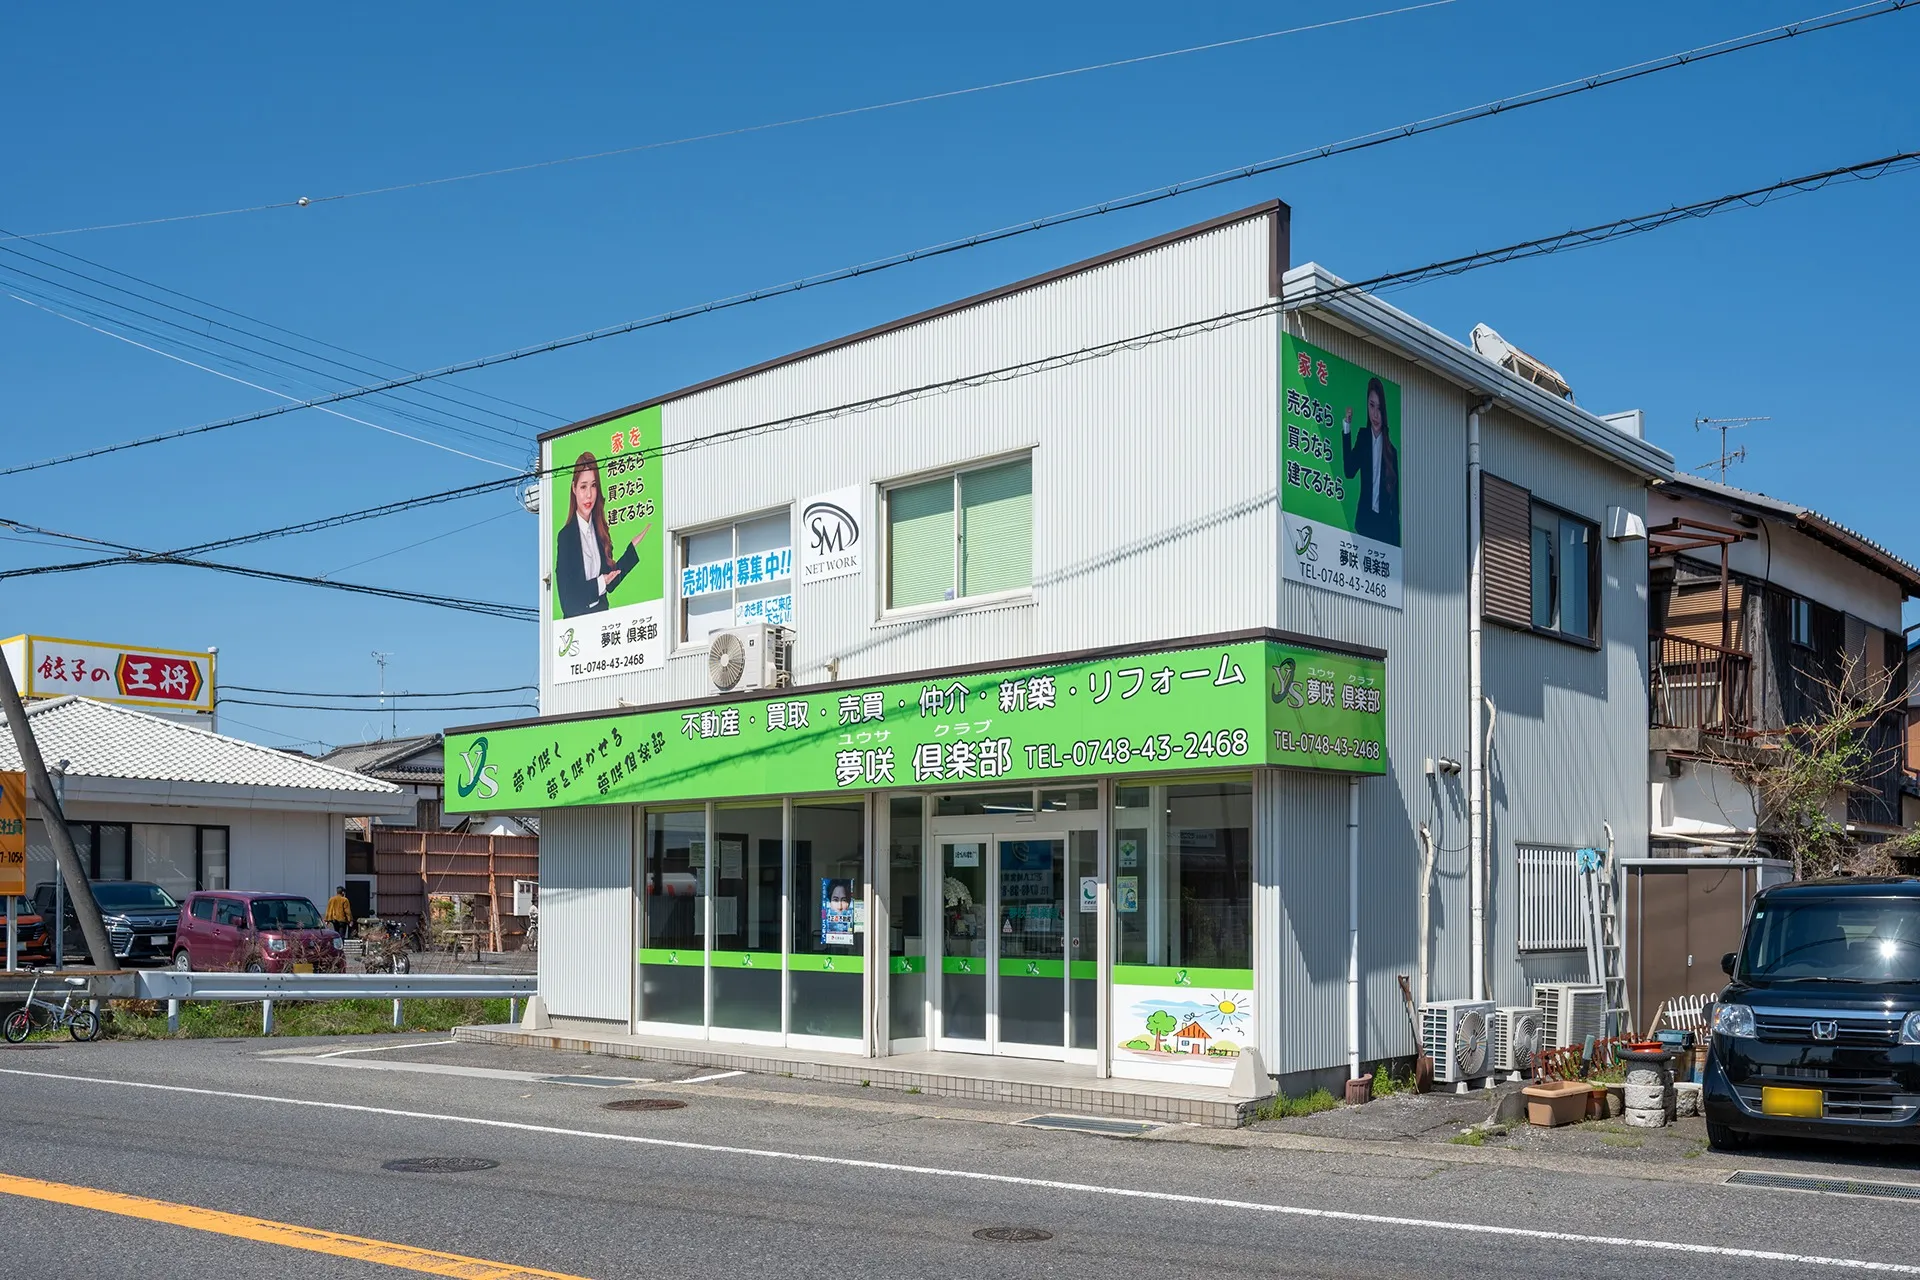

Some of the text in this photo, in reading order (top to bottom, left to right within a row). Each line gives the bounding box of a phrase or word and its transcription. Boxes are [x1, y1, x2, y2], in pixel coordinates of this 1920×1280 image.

[1298, 352, 1328, 386] 家を
[1287, 388, 1334, 427] 売るなら
[611, 426, 641, 453] 家を
[1287, 424, 1333, 462] 買うなら
[607, 451, 645, 478] 売るなら
[1287, 460, 1345, 501] 建てるなら
[608, 477, 644, 502] 買うなら
[607, 499, 655, 526] 建てるなら
[811, 516, 845, 556] SM
[1340, 548, 1390, 578] 夢咲 倶楽部
[1300, 561, 1387, 599] TEL-0748-43-2468
[601, 623, 658, 648] 夢咲 倶楽部
[37, 655, 191, 695] 餃子の 王将
[570, 653, 645, 676] TEL-0748-43-2468
[1306, 678, 1380, 714] 夢咲 倶楽部
[837, 719, 994, 747] ユウサ クラブ
[1273, 729, 1380, 761] TEL-0748-43-2468
[835, 728, 1249, 788] 夢咲 倶楽部 TEL-0748-43-2468
[0, 818, 23, 835] 社員
